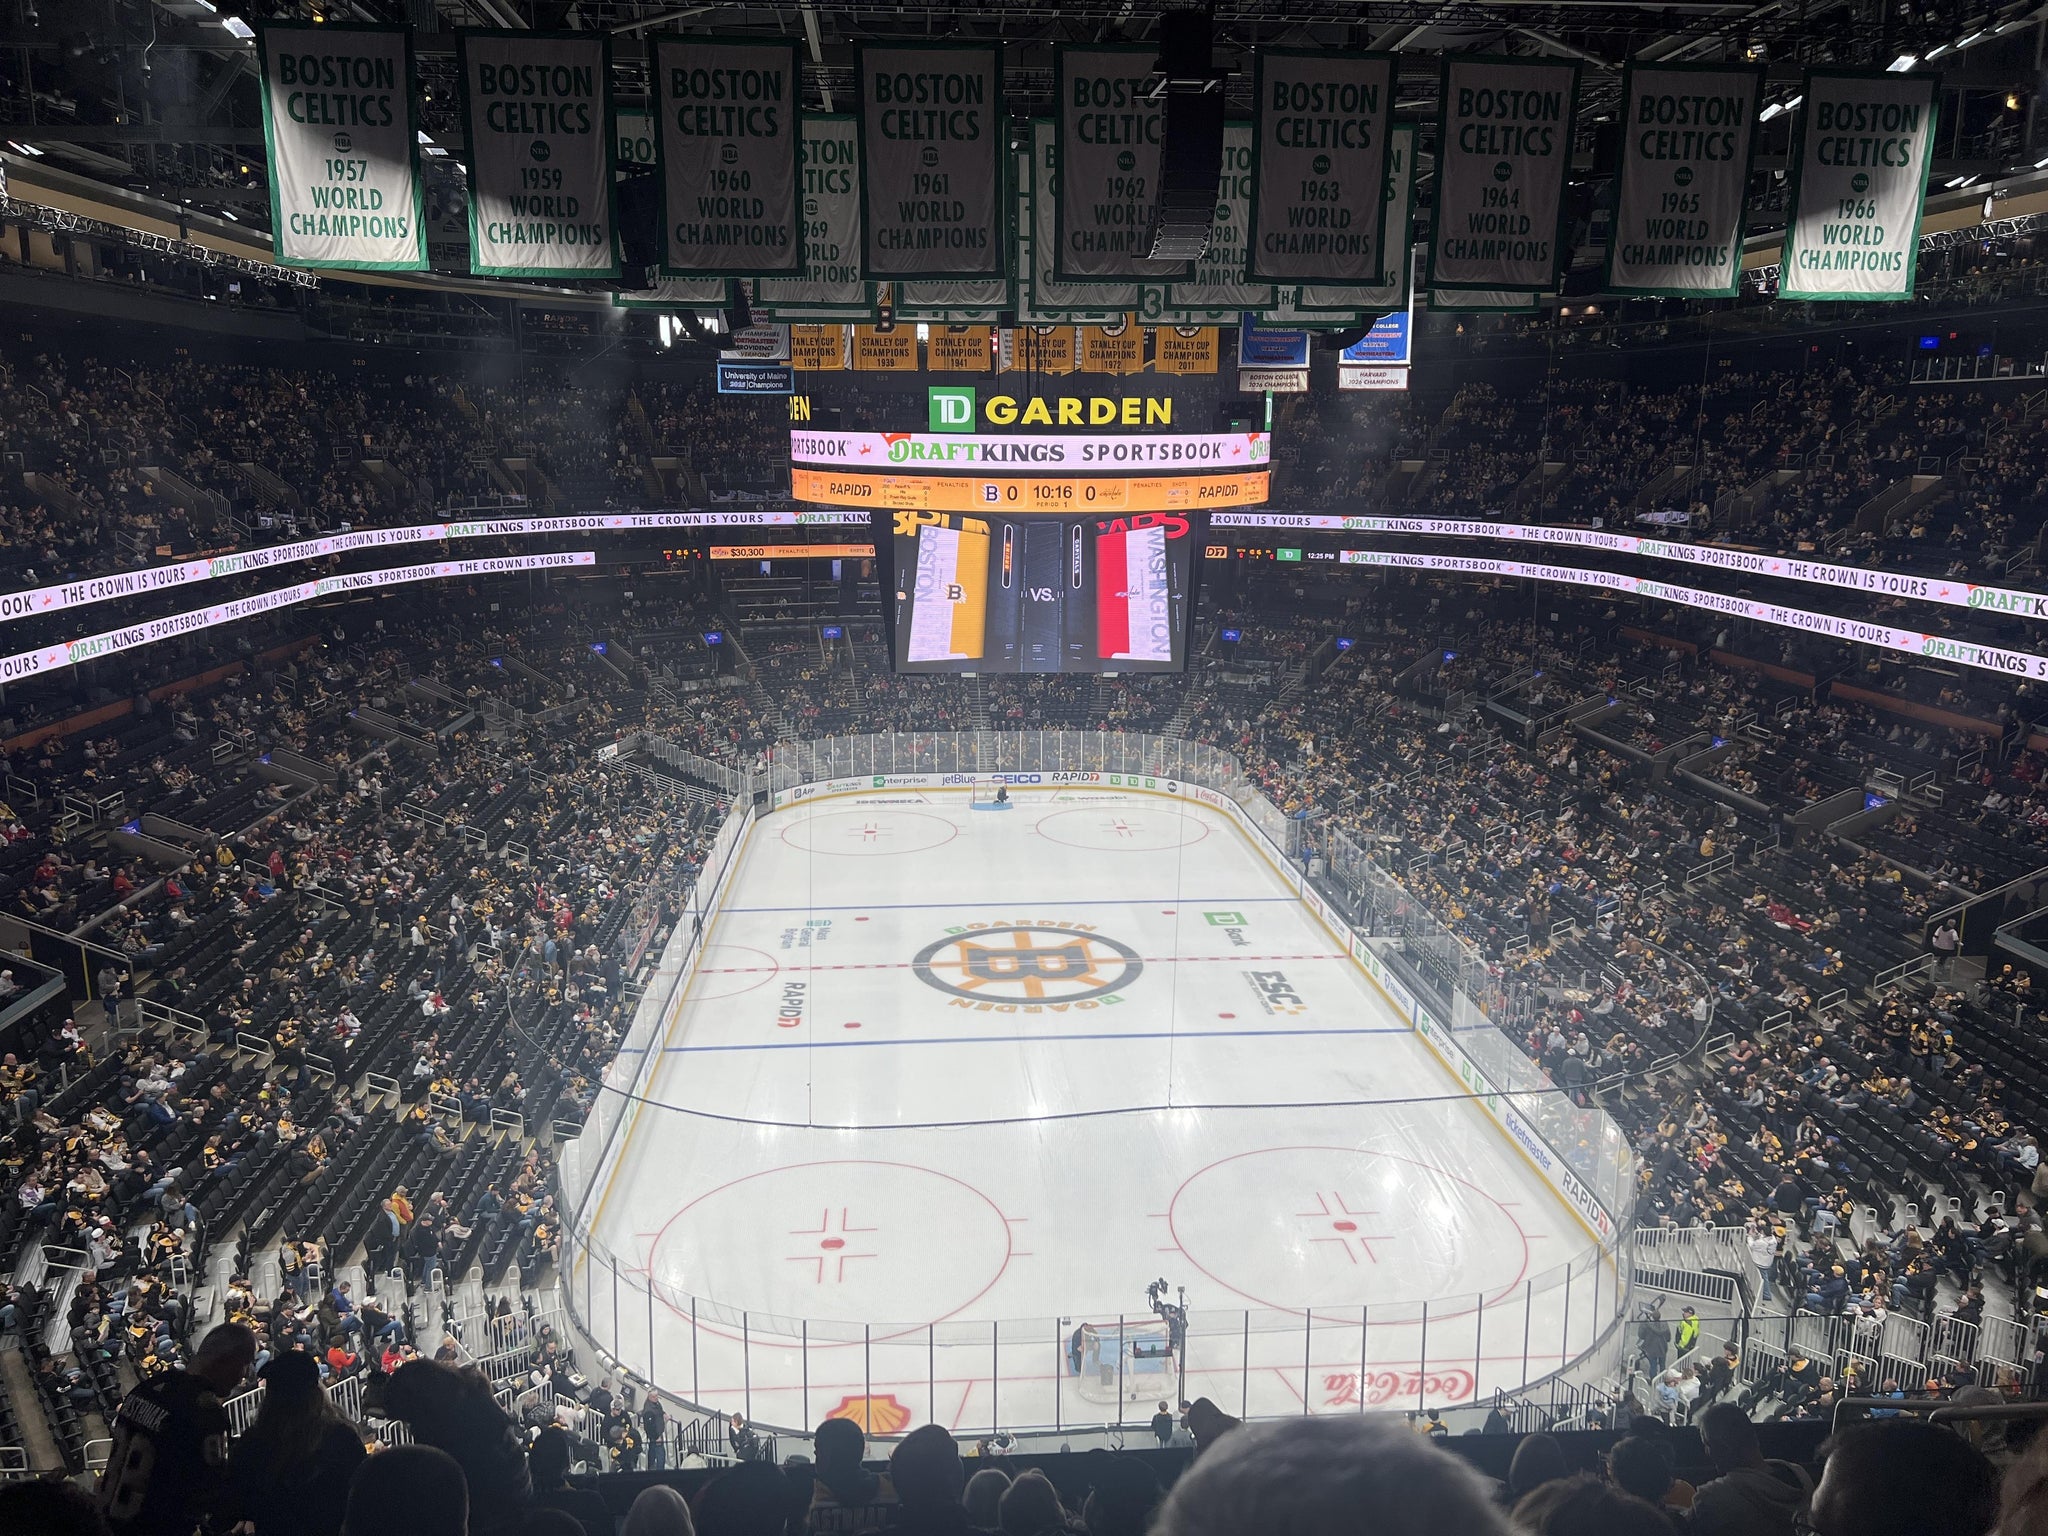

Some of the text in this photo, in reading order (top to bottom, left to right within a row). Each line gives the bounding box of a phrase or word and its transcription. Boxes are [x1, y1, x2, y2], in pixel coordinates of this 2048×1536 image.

[279, 53, 394, 90] BOSTON
[480, 63, 592, 98] BOSTON
[671, 68, 781, 101] BOSTON
[876, 72, 983, 104] BOSTON
[1074, 77, 1160, 108] BOSTO
[287, 91, 393, 127] CELTICS
[1272, 82, 1377, 115] BOSTON
[1458, 88, 1561, 121] BOSTON
[487, 101, 591, 135] CELTICS
[677, 105, 778, 137] CELTICS
[1639, 95, 1743, 127] BOSTON
[1817, 102, 1919, 134] BOSTON
[880, 109, 980, 141] CELTICS
[1077, 113, 1159, 144] CELTIC
[1277, 117, 1371, 149] CELTICS
[1459, 124, 1552, 156] CELTICS
[1639, 130, 1734, 161] CELTICS
[1817, 136, 1911, 167] CELTICS
[802, 139, 854, 165] STON
[326, 159, 367, 182] 1957
[521, 167, 563, 190] 1959
[710, 169, 750, 192] 1960
[914, 173, 949, 196] 1961
[1107, 177, 1145, 198] 1962
[1300, 180, 1339, 201] 1963
[312, 186, 383, 210] WORLD
[509, 195, 579, 219] WORLD
[698, 197, 764, 220] WORLD
[1482, 187, 1519, 209] 1964
[1661, 192, 1699, 214] 1965
[1838, 199, 1875, 219] 1966
[899, 200, 965, 223] WORLD
[1288, 207, 1351, 228] WORLD
[290, 213, 408, 238] CHAMPIONS
[488, 222, 601, 246] CHAMPIONS
[676, 223, 787, 246] CHAMPIONS
[803, 221, 828, 238] 969
[1215, 226, 1238, 243] 981
[1468, 213, 1531, 236] WORLD
[1646, 219, 1708, 242] WORLD
[1823, 223, 1885, 247] WORLD
[877, 228, 987, 250] CHAMPIONS
[1265, 233, 1370, 255] CHAMPIONS
[803, 244, 840, 261] ORLD
[1444, 239, 1548, 263] CHAMPIONS
[1622, 243, 1727, 267] CHAMPIONS
[1799, 249, 1903, 271] CHAMPIONS
[1143, 289, 1162, 319] 3
[792, 338, 835, 346] TANLEY CUP
[793, 347, 836, 357] HAMPIONS
[861, 348, 910, 357] CHAMPIONS
[862, 338, 909, 347] STANLEY CUP
[935, 338, 982, 347] STANLEY CUP
[935, 348, 983, 358] CHAMPIONS
[1019, 349, 1067, 358] CHAMPIONS
[1050, 339, 1066, 348] CUP
[1090, 340, 1136, 349] STANLEY CUP
[1164, 341, 1210, 350] STANLEY CUP
[877, 358, 895, 367] 1939
[951, 358, 968, 368] 1941
[1089, 350, 1137, 360] CHAMPIONS
[1104, 360, 1122, 370] 1972
[1163, 351, 1210, 361] CHAMPIONS
[1178, 361, 1194, 370] 2011
[724, 372, 788, 383] University of Maine
[748, 381, 784, 389] Champions
[932, 395, 1172, 425] TD GARDEN
[888, 439, 1221, 463] DRAFTKINGS SPORTSBOOK
[986, 486, 1018, 501] B 0
[1033, 485, 1072, 498] 10:16
[1085, 486, 1096, 501] 0
[62, 514, 764, 604] THE CROWN YOURS SPORTSBOOK CROWN YOURS SPORTSBOOK THE CROWN YOURS
[730, 548, 765, 557] $30,300
[915, 527, 938, 602] BOSTON
[1271, 516, 1311, 526] YOURS
[1430, 522, 1501, 536] SPORTSBOOK
[1521, 528, 1539, 539] THE
[1543, 530, 1581, 543] CROWN
[1594, 534, 1618, 548] YOURS
[1701, 550, 1764, 571] SPORTSBOOK
[1787, 562, 1807, 577] THE
[1812, 566, 1858, 586] CROWN
[1881, 577, 1928, 596] YOURS
[1967, 587, 2048, 617] DRAFTK
[150, 555, 574, 638] SPORTSBOOK THE CROWN YOURS SPORTSBOOK THE CROWN YOURS
[1030, 587, 1055, 602] VS.
[1147, 527, 1171, 653] WASHINGTON
[1430, 557, 1501, 571] SPORTSBOOK
[1520, 565, 1537, 575] THE
[1540, 567, 1576, 581] CROWN
[1593, 573, 1620, 587] YOURS
[1693, 592, 1750, 614] SPORTSBOOK
[1770, 608, 1787, 622] THE
[1792, 612, 1831, 632] CROWN
[1851, 623, 1891, 643] YOURS
[1922, 637, 2027, 673] DRAFTKINGS
[873, 776, 927, 788] enterprise
[941, 774, 976, 785] jetBlue
[991, 774, 1041, 783] GEICO
[966, 920, 1097, 932] GARDEN
[1224, 928, 1252, 946] Bank
[1251, 971, 1304, 1004] ESC
[948, 997, 1100, 1014] GARDEN
[1505, 1112, 1552, 1171] ticketmaster
[1324, 1368, 1475, 1406] Coca-Cola
